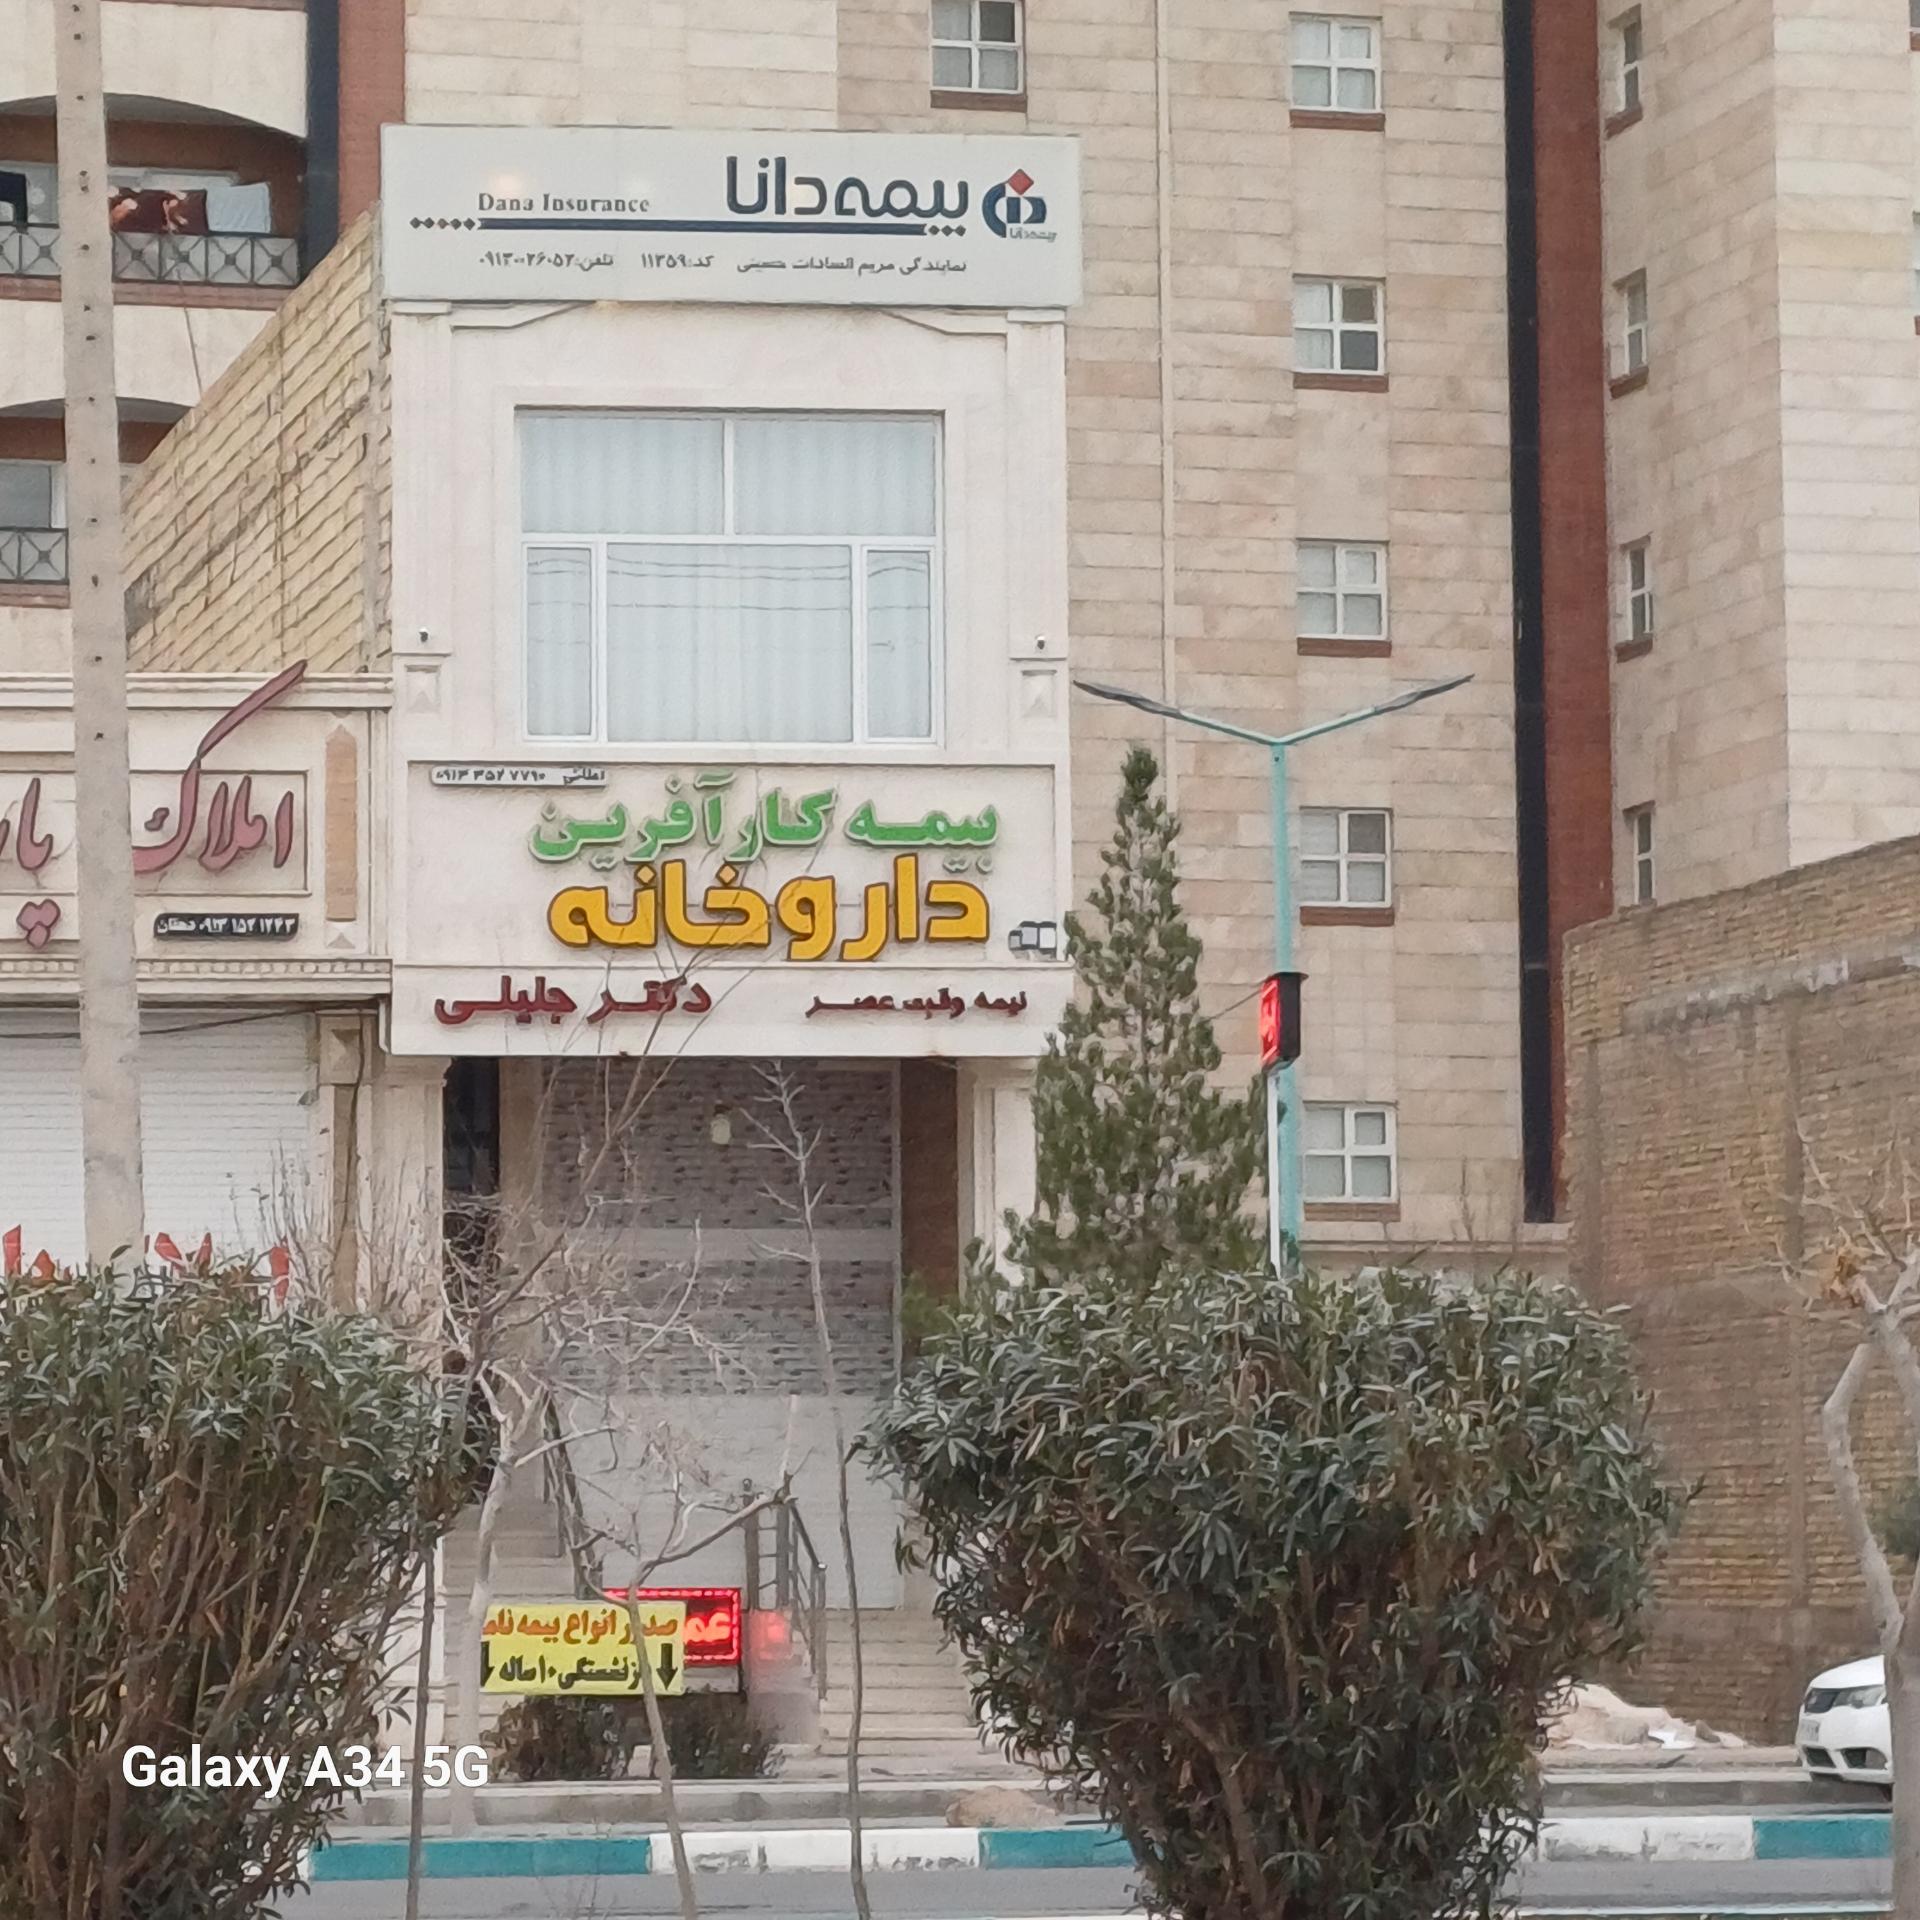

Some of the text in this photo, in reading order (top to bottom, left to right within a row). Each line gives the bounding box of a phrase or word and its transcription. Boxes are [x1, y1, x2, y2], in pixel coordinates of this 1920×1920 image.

[477, 193, 651, 213] Dana Insurance
[726, 156, 969, 237] بیمه دانا
[857, 260, 895, 278] مریم
[900, 256, 967, 276] نمایندگی
[843, 799, 999, 874] بیمه
[546, 852, 990, 962] داروخانه
[434, 974, 579, 1025] جلیلی
[480, 1607, 678, 1646] صدر انواع بیمه نام
